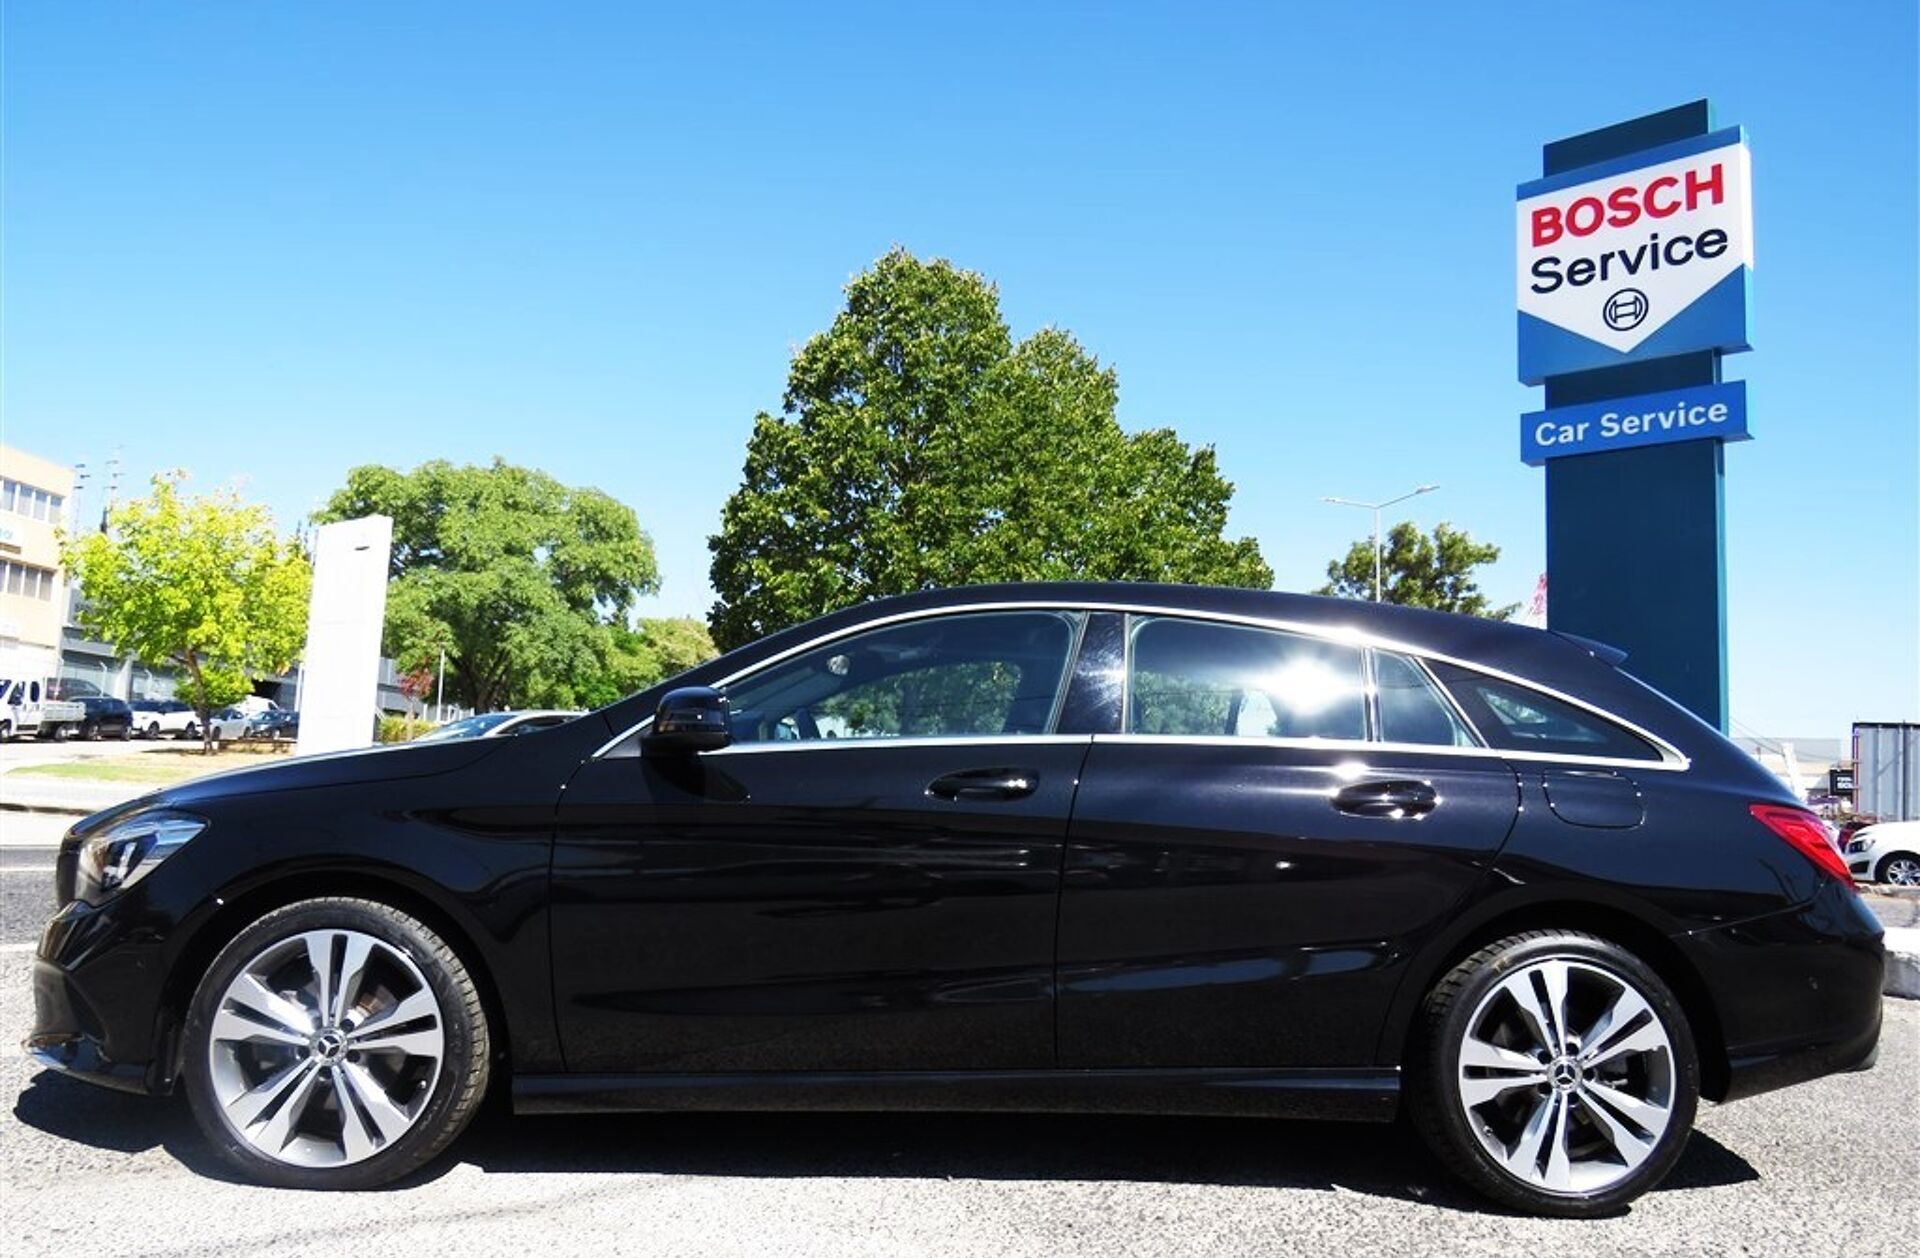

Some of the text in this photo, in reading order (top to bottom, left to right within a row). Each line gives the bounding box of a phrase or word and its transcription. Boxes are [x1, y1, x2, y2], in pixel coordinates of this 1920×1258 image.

[1531, 163, 1724, 248] BOSCH
[1530, 228, 1728, 294] Service
[1534, 402, 1729, 446] Car Service
